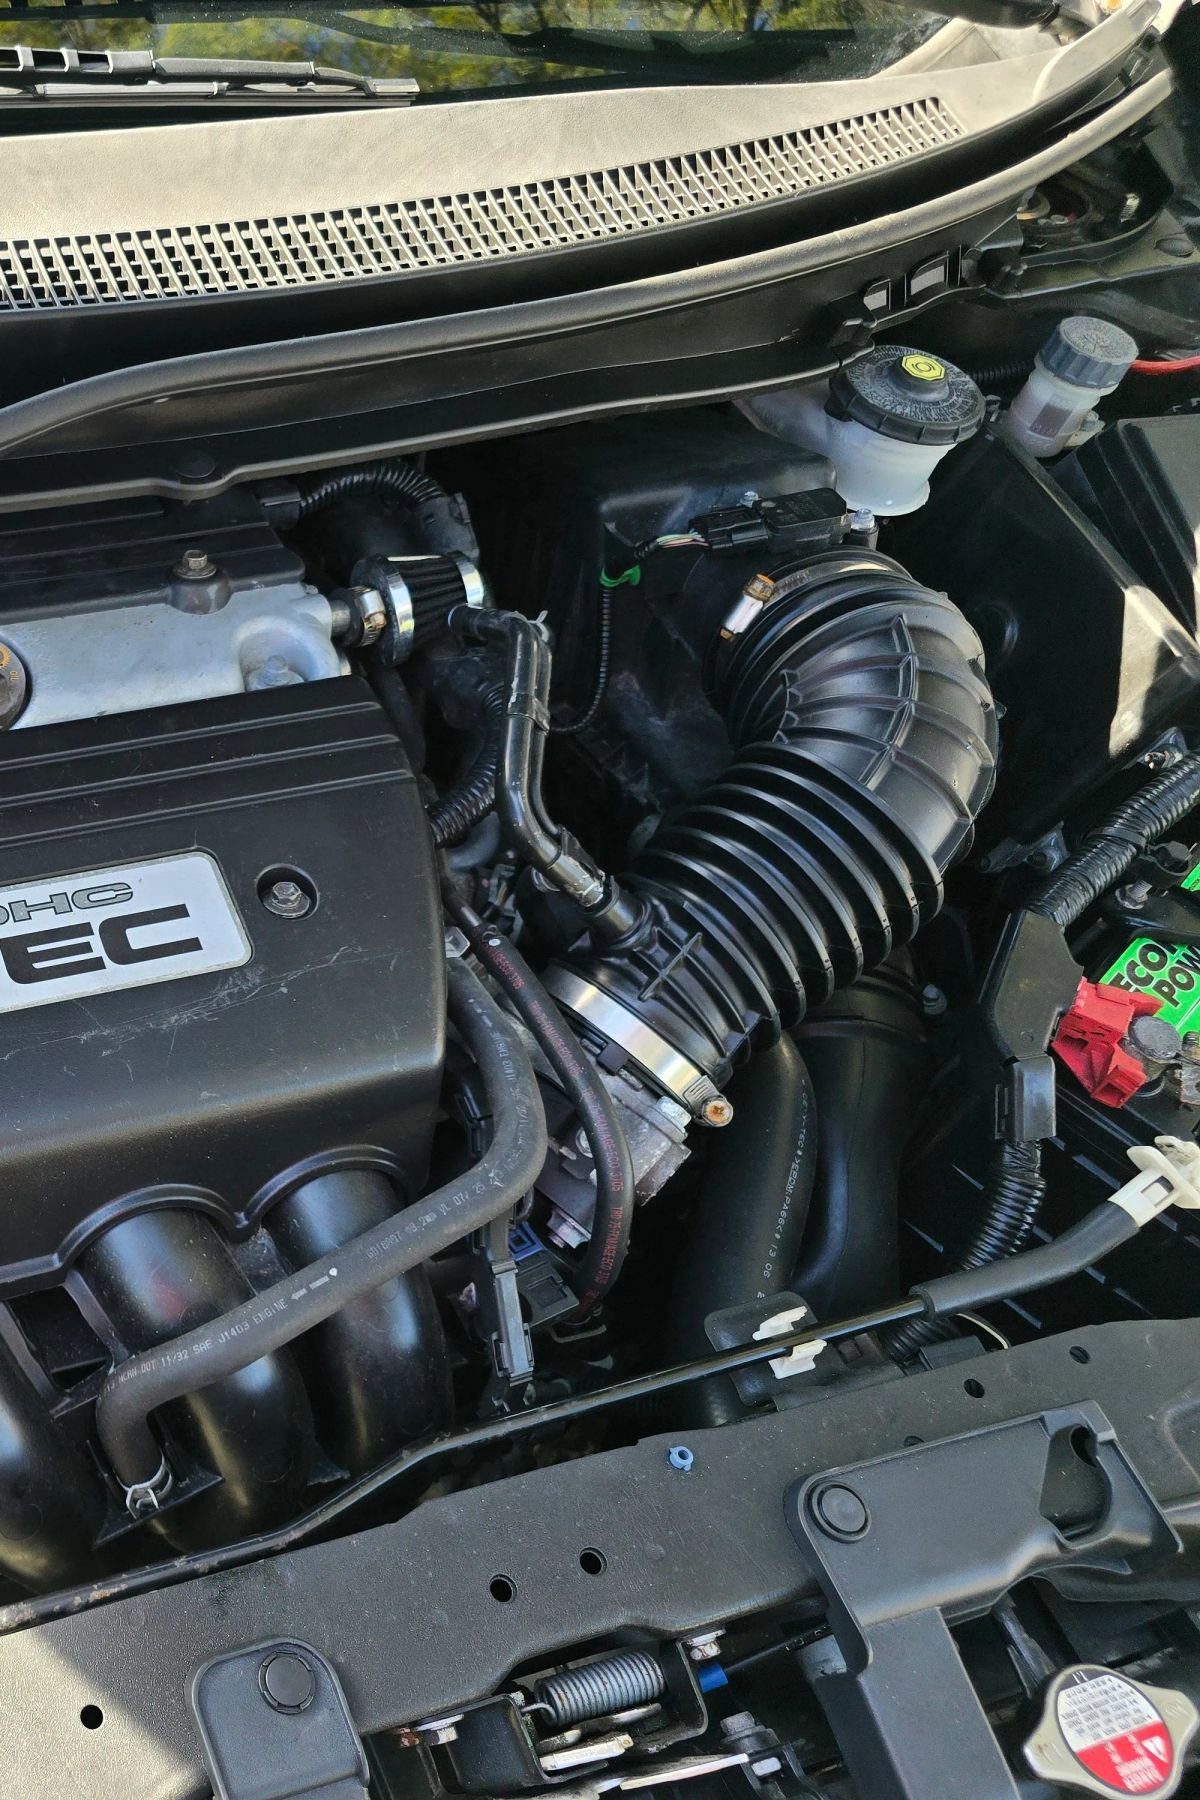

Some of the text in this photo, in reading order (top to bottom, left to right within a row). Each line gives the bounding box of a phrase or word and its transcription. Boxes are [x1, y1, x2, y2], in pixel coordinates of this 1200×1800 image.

[160, 1349, 190, 1368] 11/32
[192, 1338, 214, 1356] SAE
[252, 1297, 289, 1326] ENGINE
